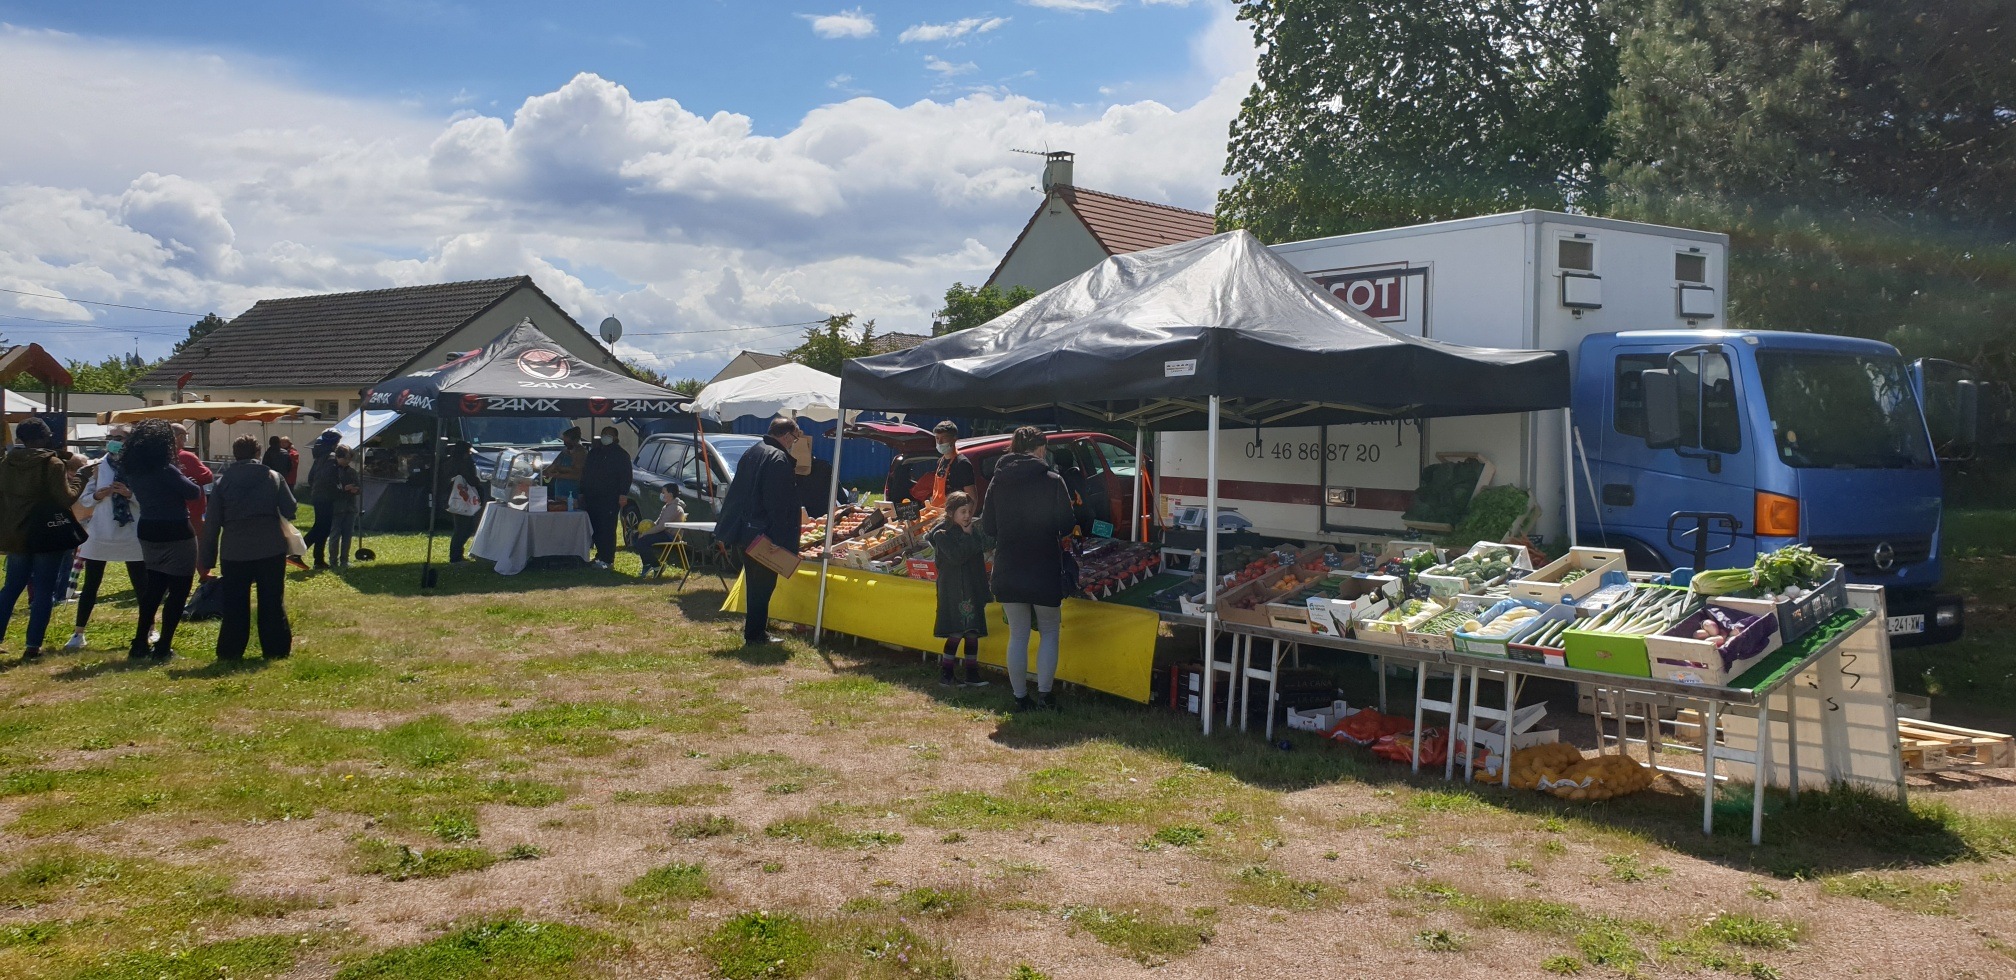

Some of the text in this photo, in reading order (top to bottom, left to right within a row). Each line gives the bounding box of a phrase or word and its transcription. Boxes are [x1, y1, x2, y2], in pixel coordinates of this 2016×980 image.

[517, 381, 596, 390] 24MX
[404, 394, 435, 410] 24MX
[486, 399, 561, 412] 24MX
[612, 400, 681, 414] 24MX
[1245, 442, 1381, 462] 01 46 86 87 20
